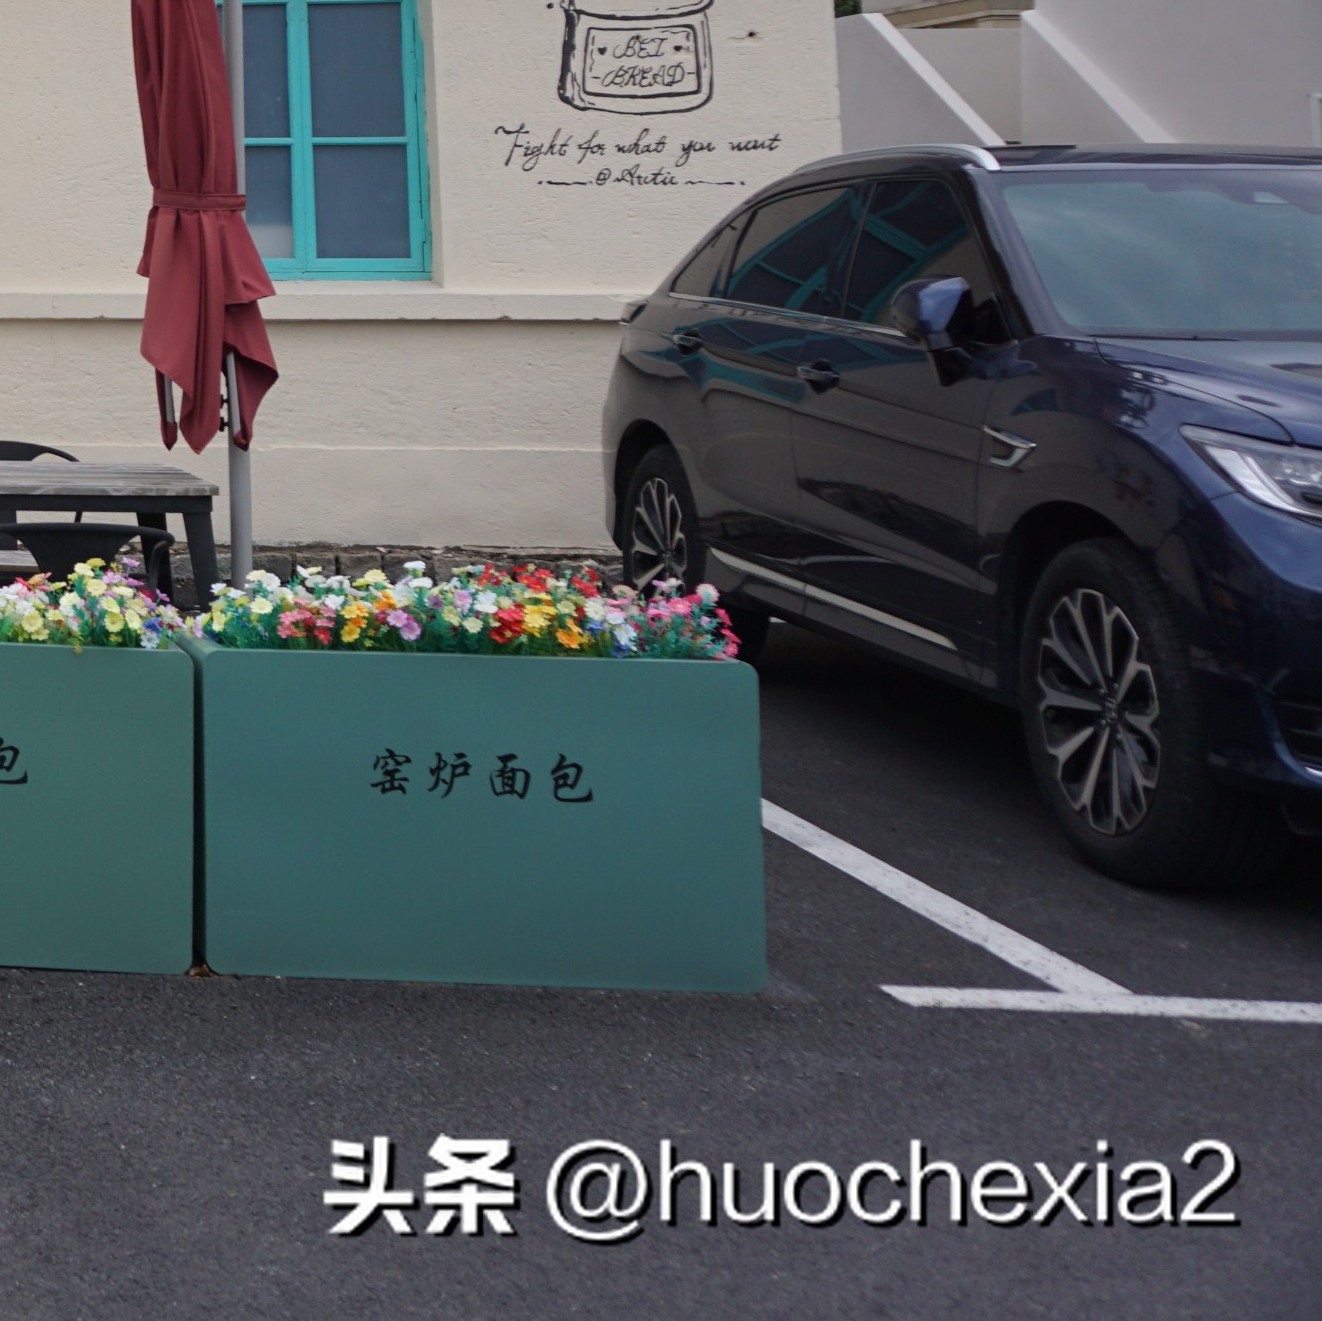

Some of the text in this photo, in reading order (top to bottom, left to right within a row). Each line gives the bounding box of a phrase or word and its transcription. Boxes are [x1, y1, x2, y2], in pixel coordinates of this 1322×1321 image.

[494, 123, 573, 172] Fight
[578, 130, 607, 164] for
[615, 128, 668, 156] what
[675, 139, 716, 167] you
[369, 747, 595, 805] 窑炉面包
